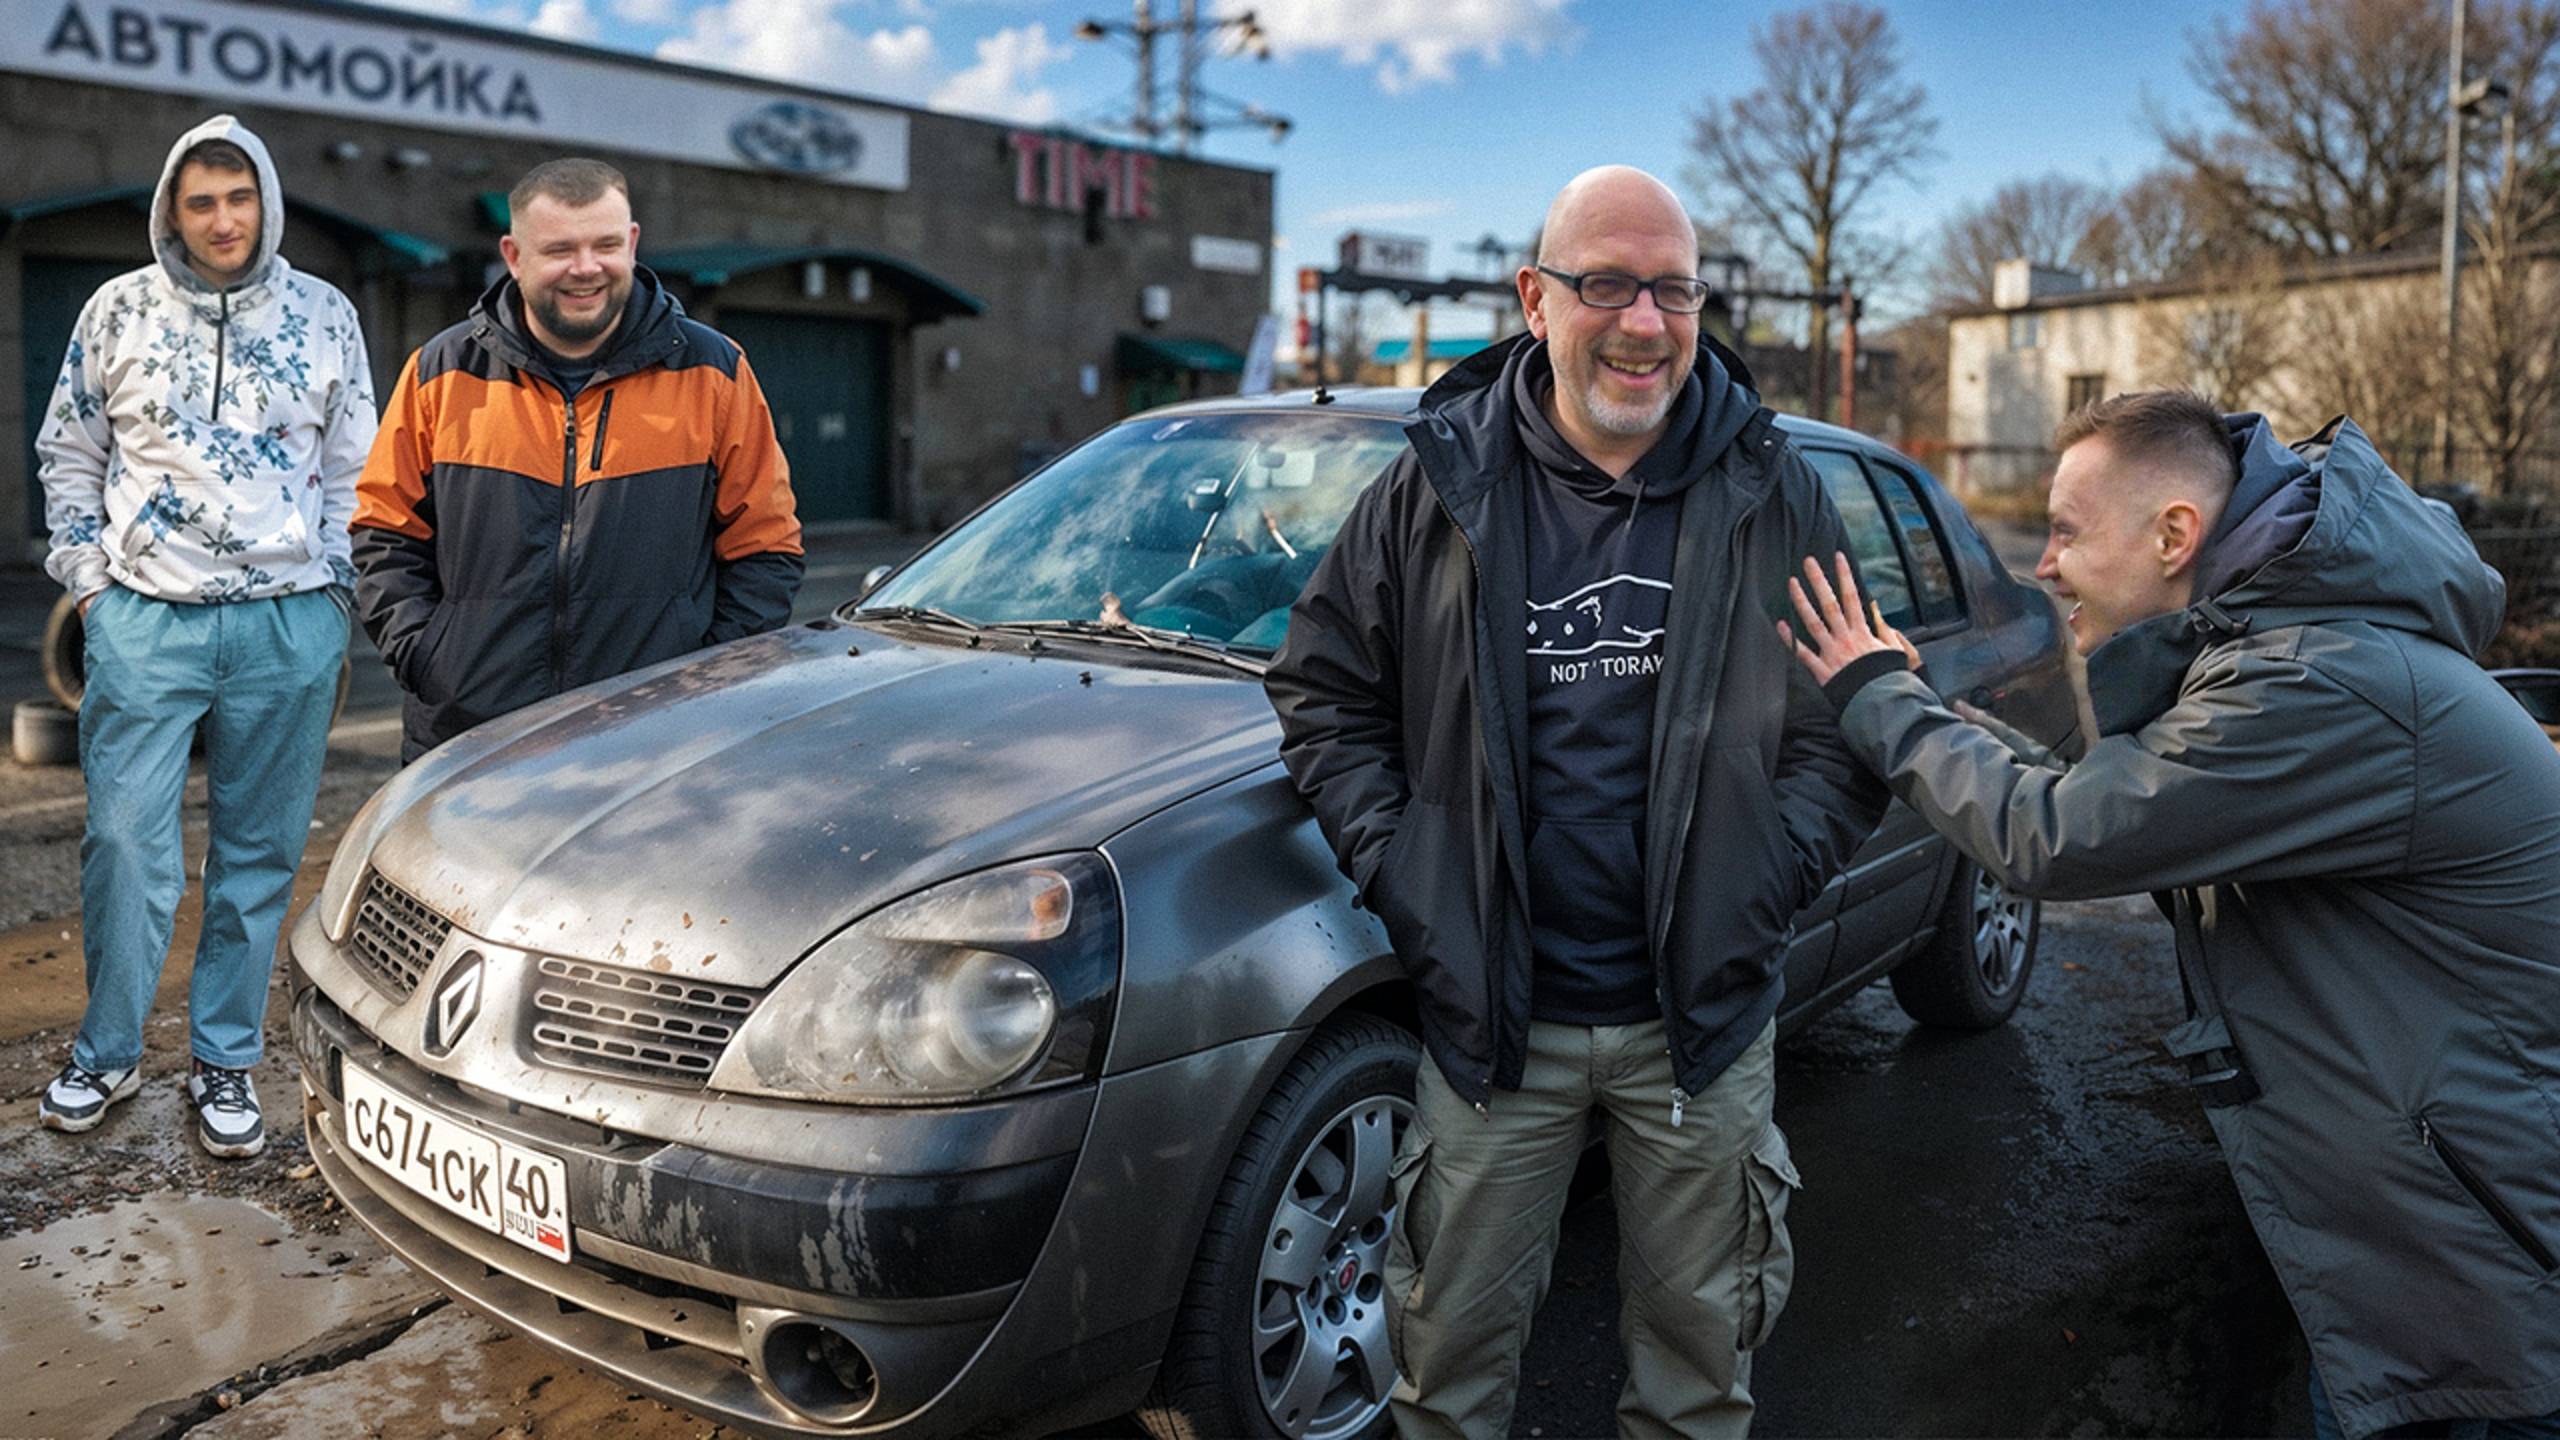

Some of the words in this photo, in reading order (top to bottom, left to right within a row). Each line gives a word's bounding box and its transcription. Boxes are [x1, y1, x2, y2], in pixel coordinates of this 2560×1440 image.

[47, 4, 541, 124] АВТОМОЙКА
[1010, 131, 1157, 218] TIME
[354, 1097, 492, 1217] С674СК
[506, 1157, 550, 1219] 40
